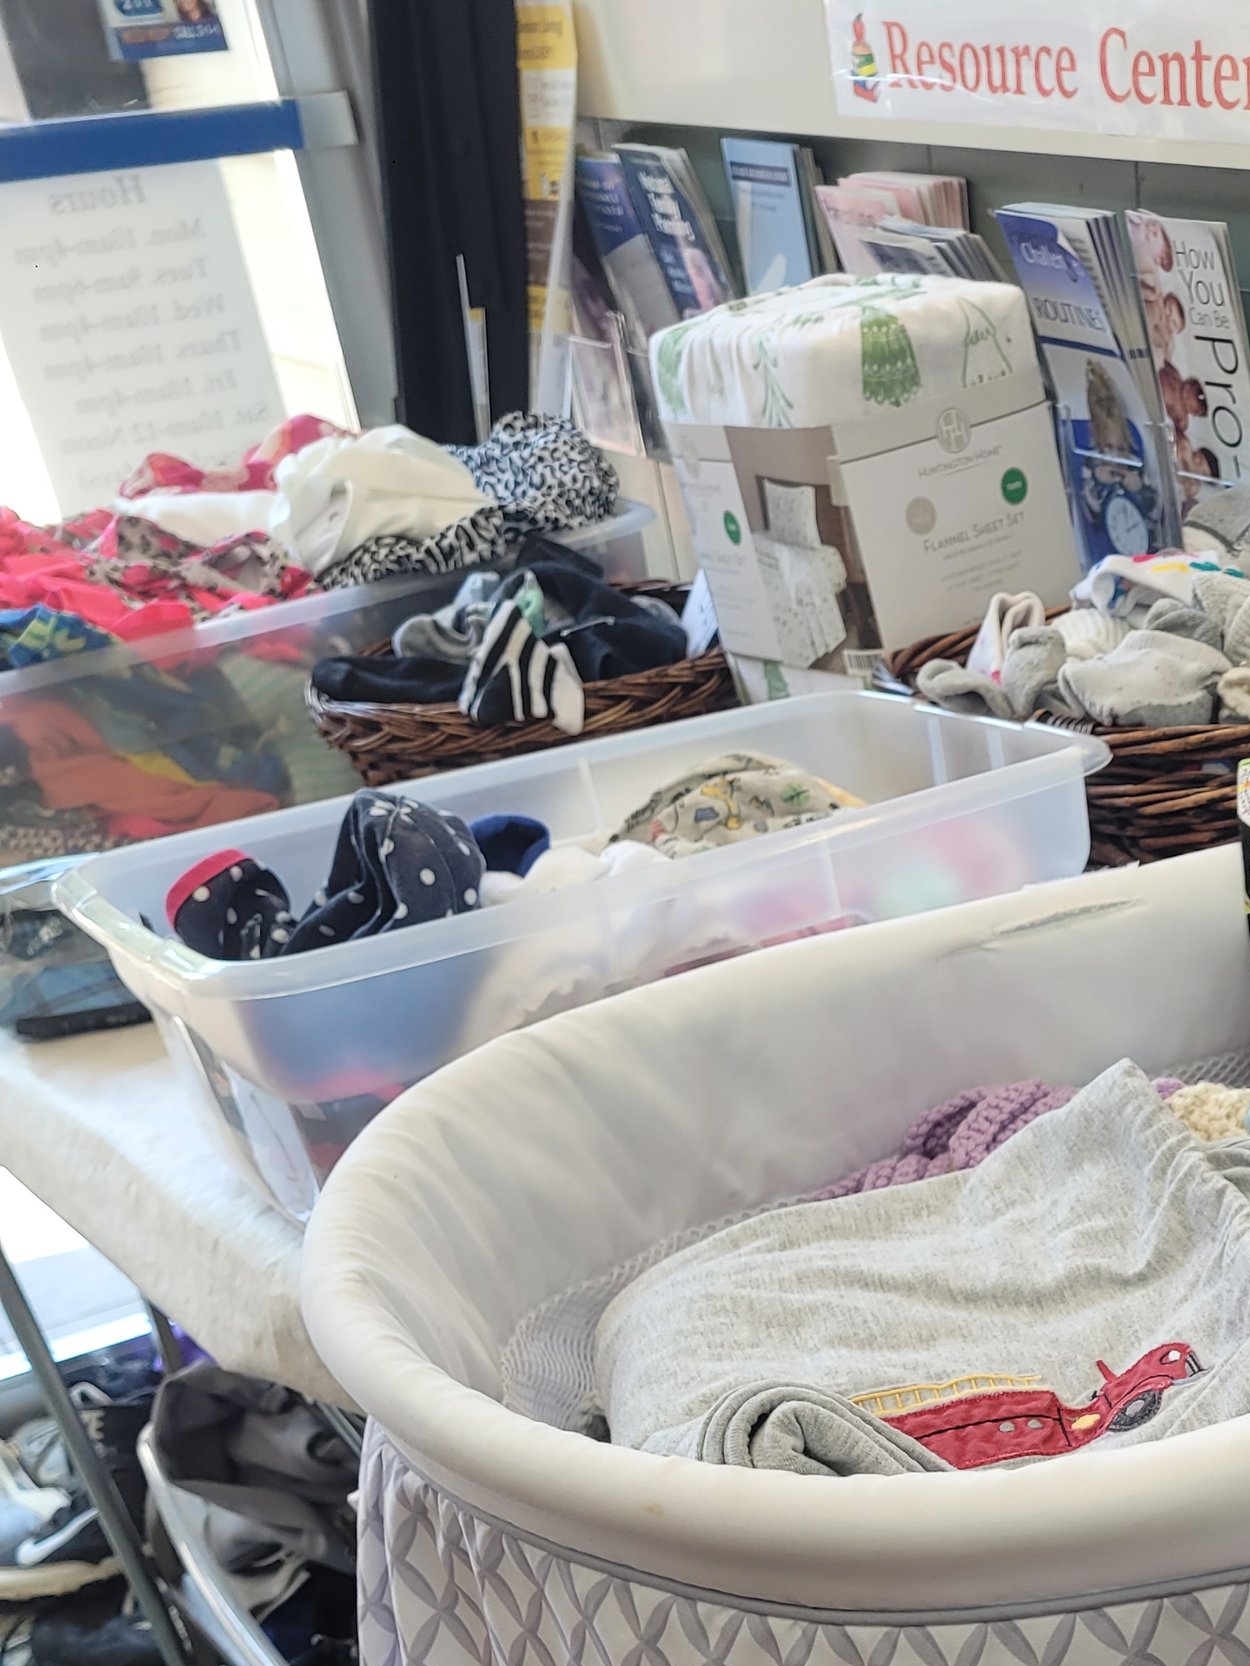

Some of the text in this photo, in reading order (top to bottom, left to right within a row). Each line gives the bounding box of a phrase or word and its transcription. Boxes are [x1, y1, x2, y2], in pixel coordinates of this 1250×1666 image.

[882, 21, 1079, 100] Resource
[1173, 239, 1215, 271] How
[1181, 270, 1225, 307] You
[1190, 306, 1230, 329] Can Be
